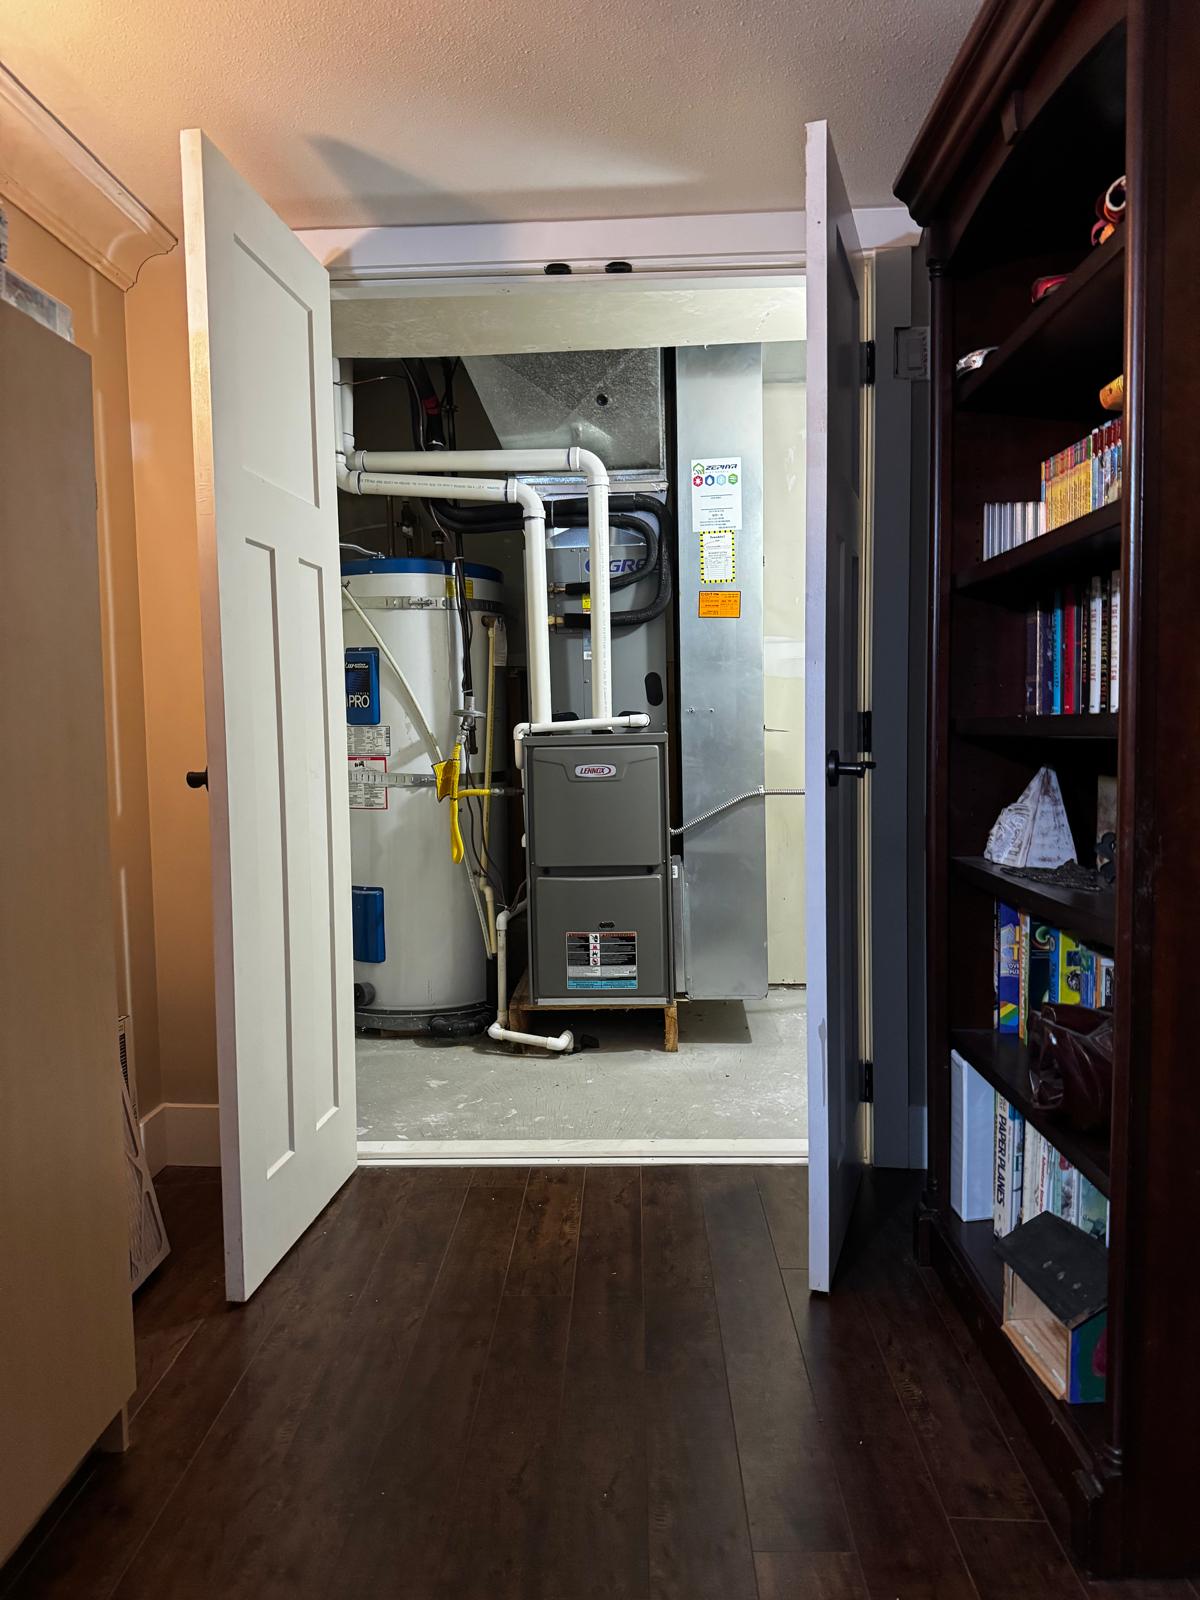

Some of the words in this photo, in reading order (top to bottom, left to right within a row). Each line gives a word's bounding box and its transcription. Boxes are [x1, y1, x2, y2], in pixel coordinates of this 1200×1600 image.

[609, 558, 650, 573] GRE
[346, 695, 370, 708] PRO
[580, 767, 606, 775] LENNOX
[997, 1114, 1008, 1156] PAPER
[997, 1156, 1006, 1208] PLANES
